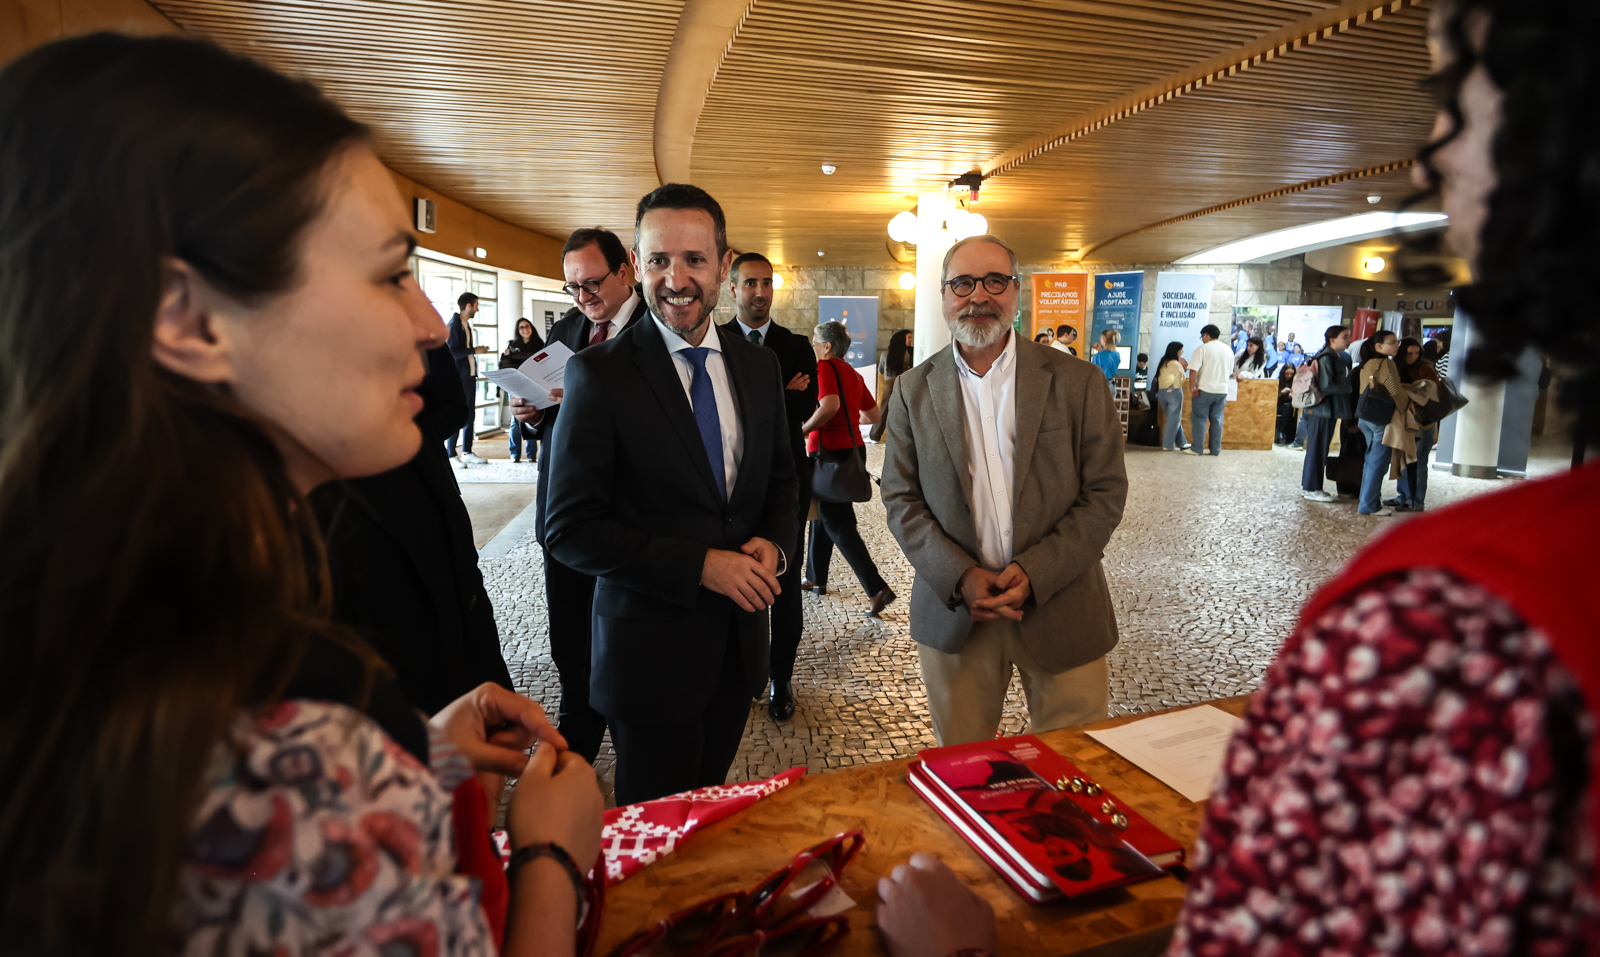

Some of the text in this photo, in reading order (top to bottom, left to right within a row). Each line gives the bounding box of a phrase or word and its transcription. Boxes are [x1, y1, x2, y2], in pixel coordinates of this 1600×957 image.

[1107, 291, 1127, 299] AJUDE
[1162, 291, 1197, 301] SOCIEDADE,
[1099, 298, 1134, 306] ADOPTANDO
[1161, 301, 1208, 310] VOLUNTARIADO
[1160, 309, 1196, 319] E INCLUSÃO
[1158, 320, 1190, 329] AAUMINHO
